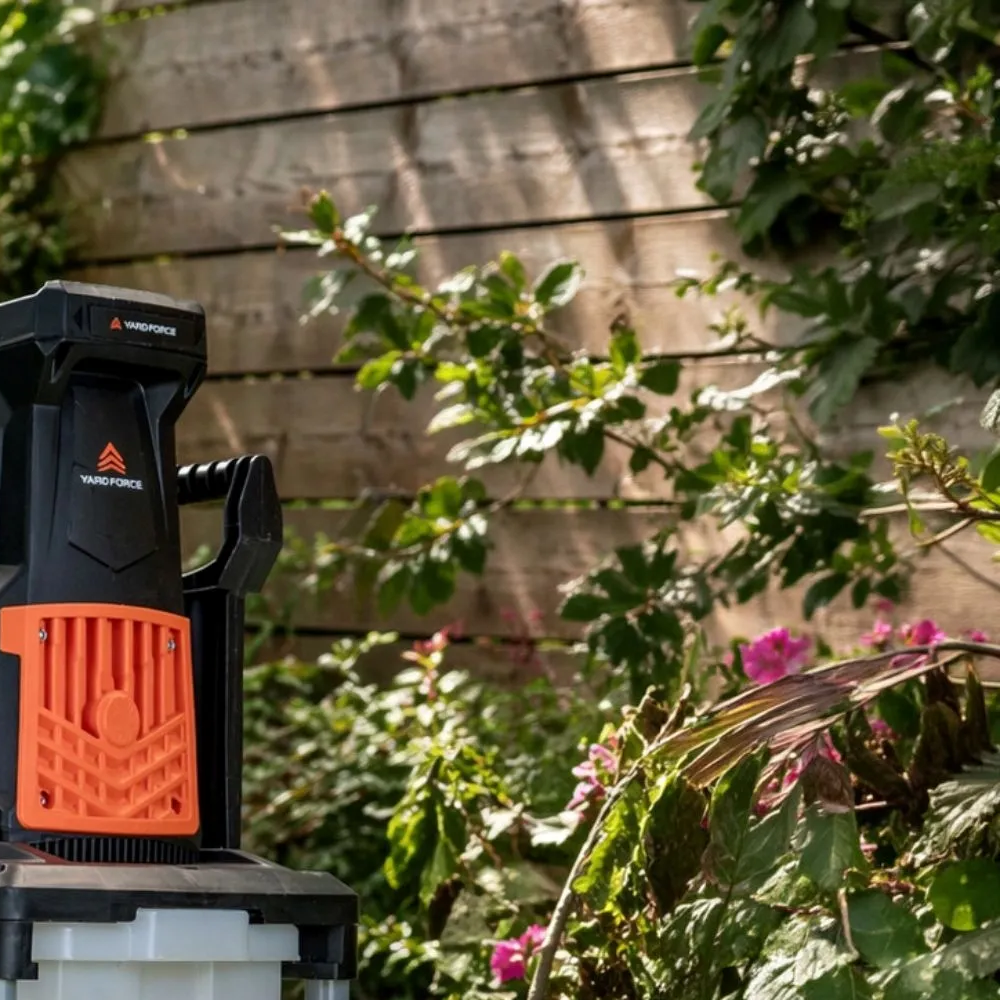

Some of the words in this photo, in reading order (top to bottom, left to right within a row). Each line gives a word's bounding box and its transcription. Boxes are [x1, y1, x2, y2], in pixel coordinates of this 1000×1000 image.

[124, 320, 149, 332] YARD
[149, 324, 177, 336] FORCE
[80, 474, 109, 486] YARD
[110, 477, 143, 490] FORCE
